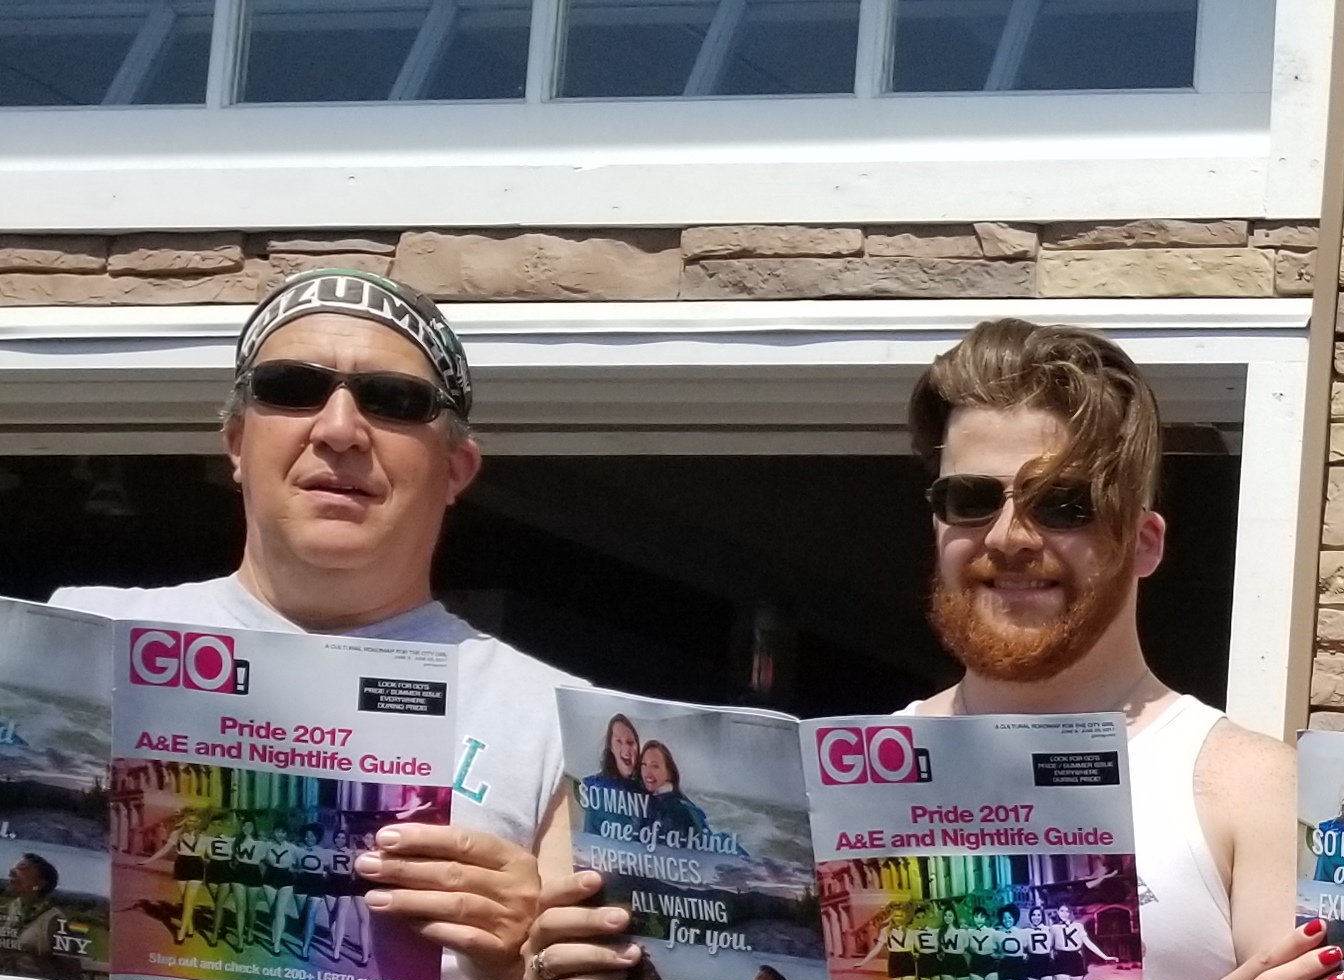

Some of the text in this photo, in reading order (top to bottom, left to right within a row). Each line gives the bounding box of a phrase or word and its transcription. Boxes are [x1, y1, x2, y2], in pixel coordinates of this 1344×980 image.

[220, 716, 353, 747] Pride 2017
[135, 731, 432, 776] A&E and Nightlife Guide
[579, 783, 650, 819] SO MANY
[910, 804, 1034, 824] Pride 2017
[600, 819, 739, 855] one-of-a-kind
[835, 827, 1114, 851] A&E and Nightlife Guide
[1312, 828, 1336, 855] SO
[631, 890, 727, 924] ALL WAITING
[666, 918, 752, 954] for you.
[149, 952, 176, 968] Step
[178, 957, 198, 969] out
[200, 959, 223, 972] and
[224, 960, 260, 975] check
[262, 963, 282, 978] out
